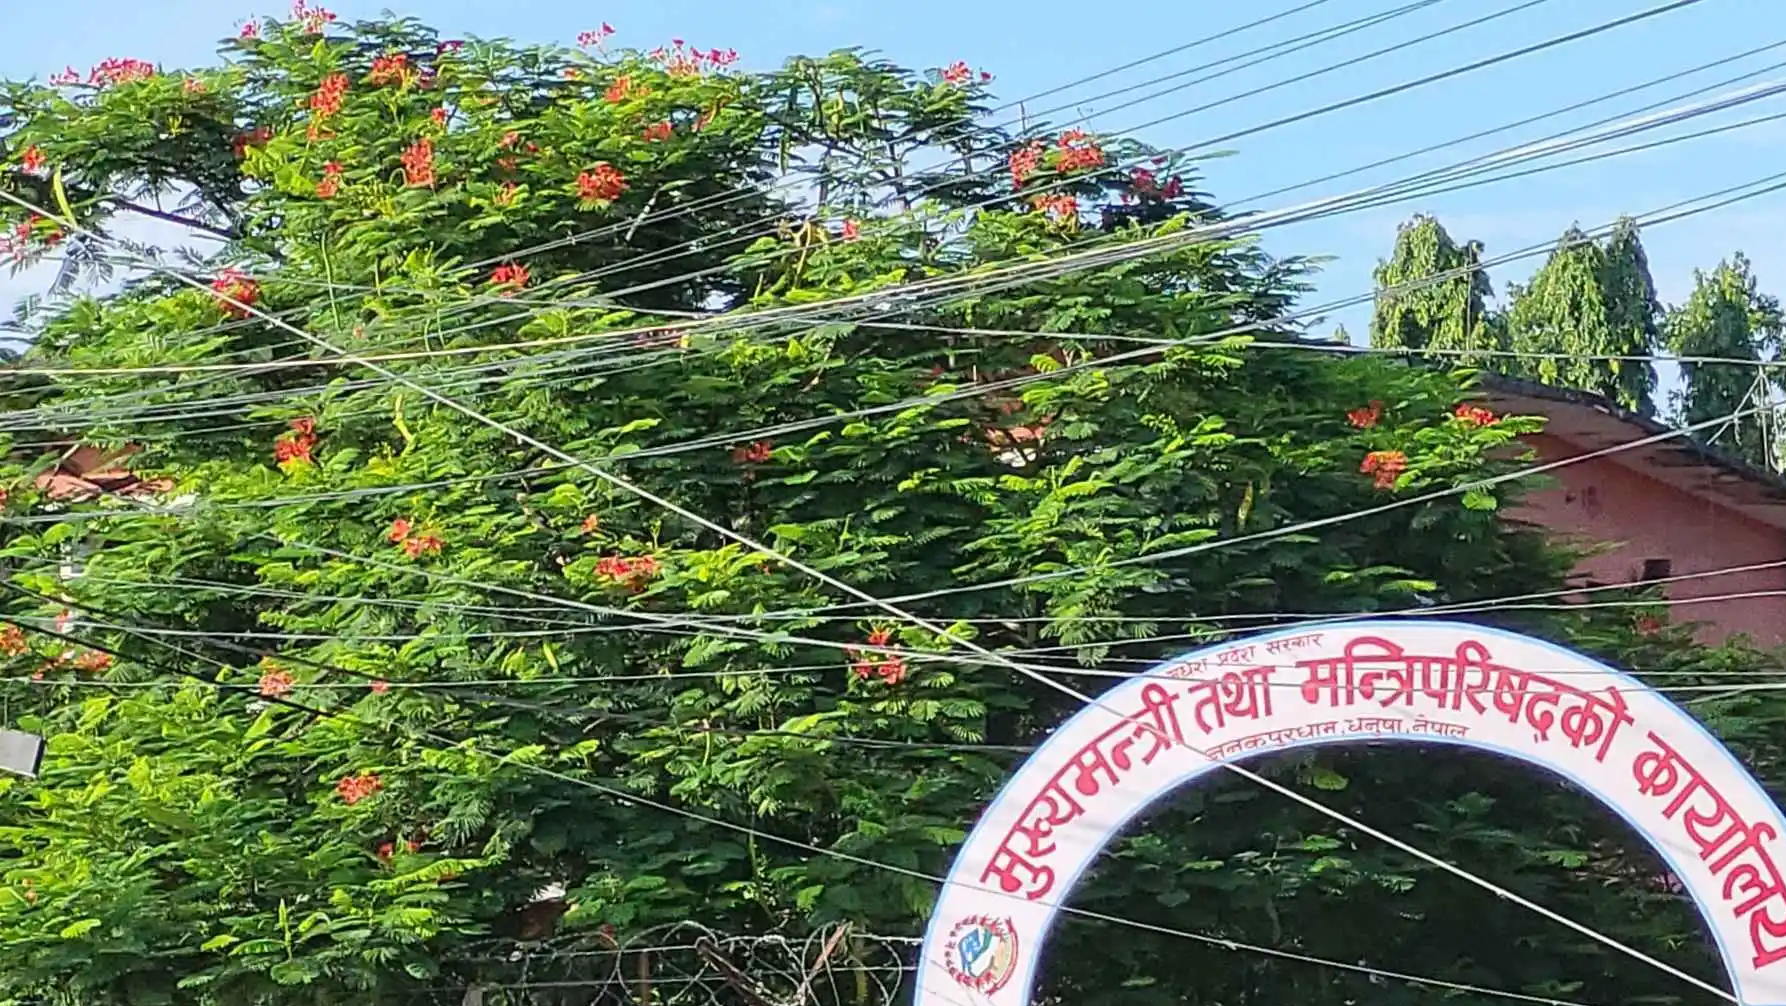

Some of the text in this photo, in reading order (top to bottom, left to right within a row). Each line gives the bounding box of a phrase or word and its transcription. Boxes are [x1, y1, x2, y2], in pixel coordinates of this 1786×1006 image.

[1265, 633, 1325, 655] सरकार
[980, 681, 1182, 901] मुख्यमन्त्री
[1188, 664, 1278, 734] तथा
